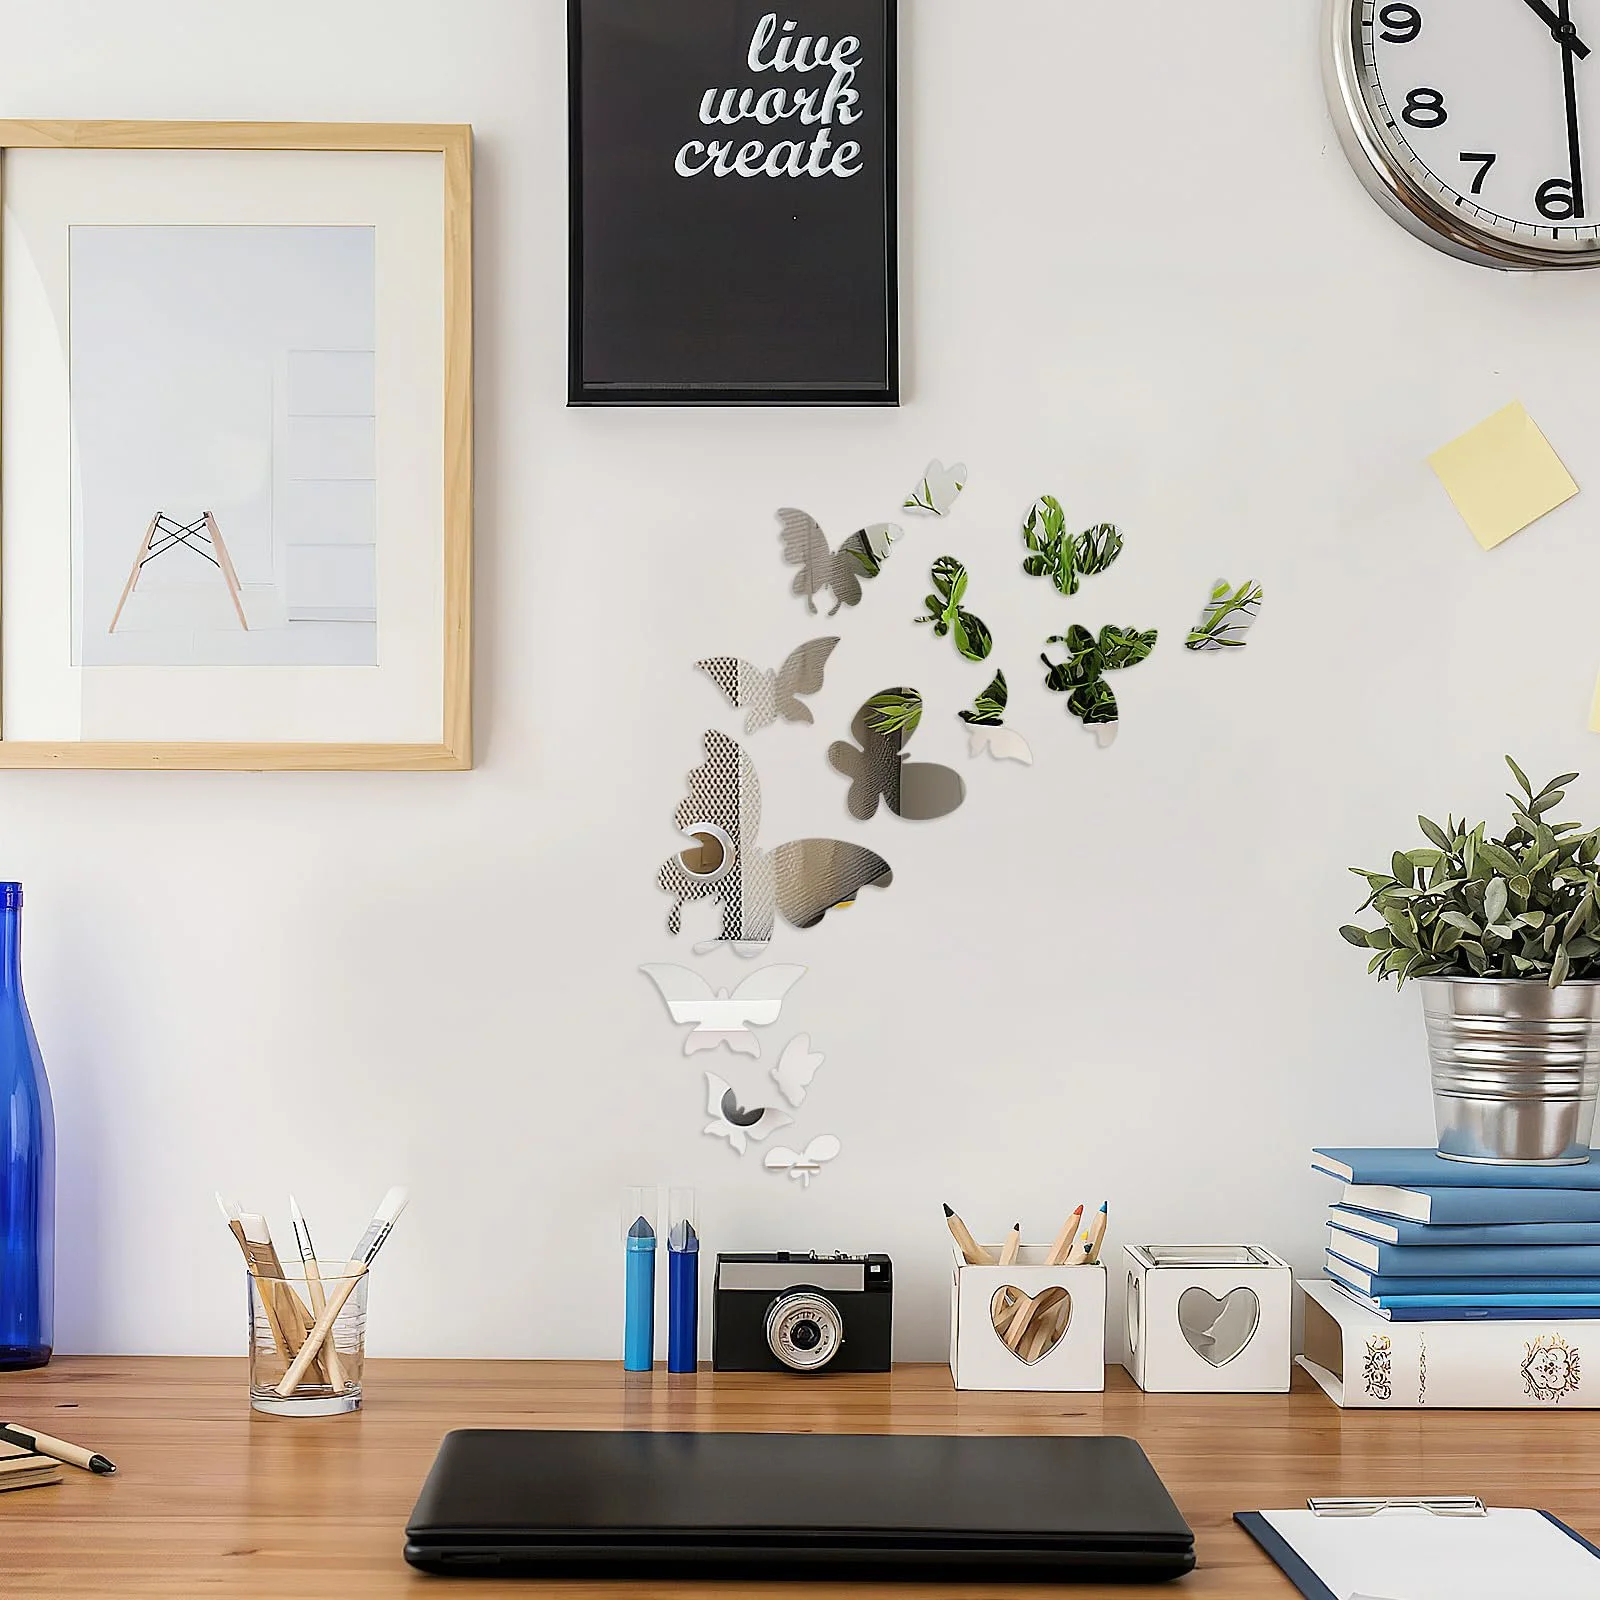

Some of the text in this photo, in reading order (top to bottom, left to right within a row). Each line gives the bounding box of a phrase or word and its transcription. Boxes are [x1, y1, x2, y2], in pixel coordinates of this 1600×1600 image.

[748, 12, 864, 72] live
[1379, 3, 1422, 44] 9
[699, 67, 864, 125] work
[1402, 88, 1448, 129] 8
[674, 127, 864, 178] create
[1459, 152, 1497, 195] 7
[1535, 178, 1575, 221] 6
